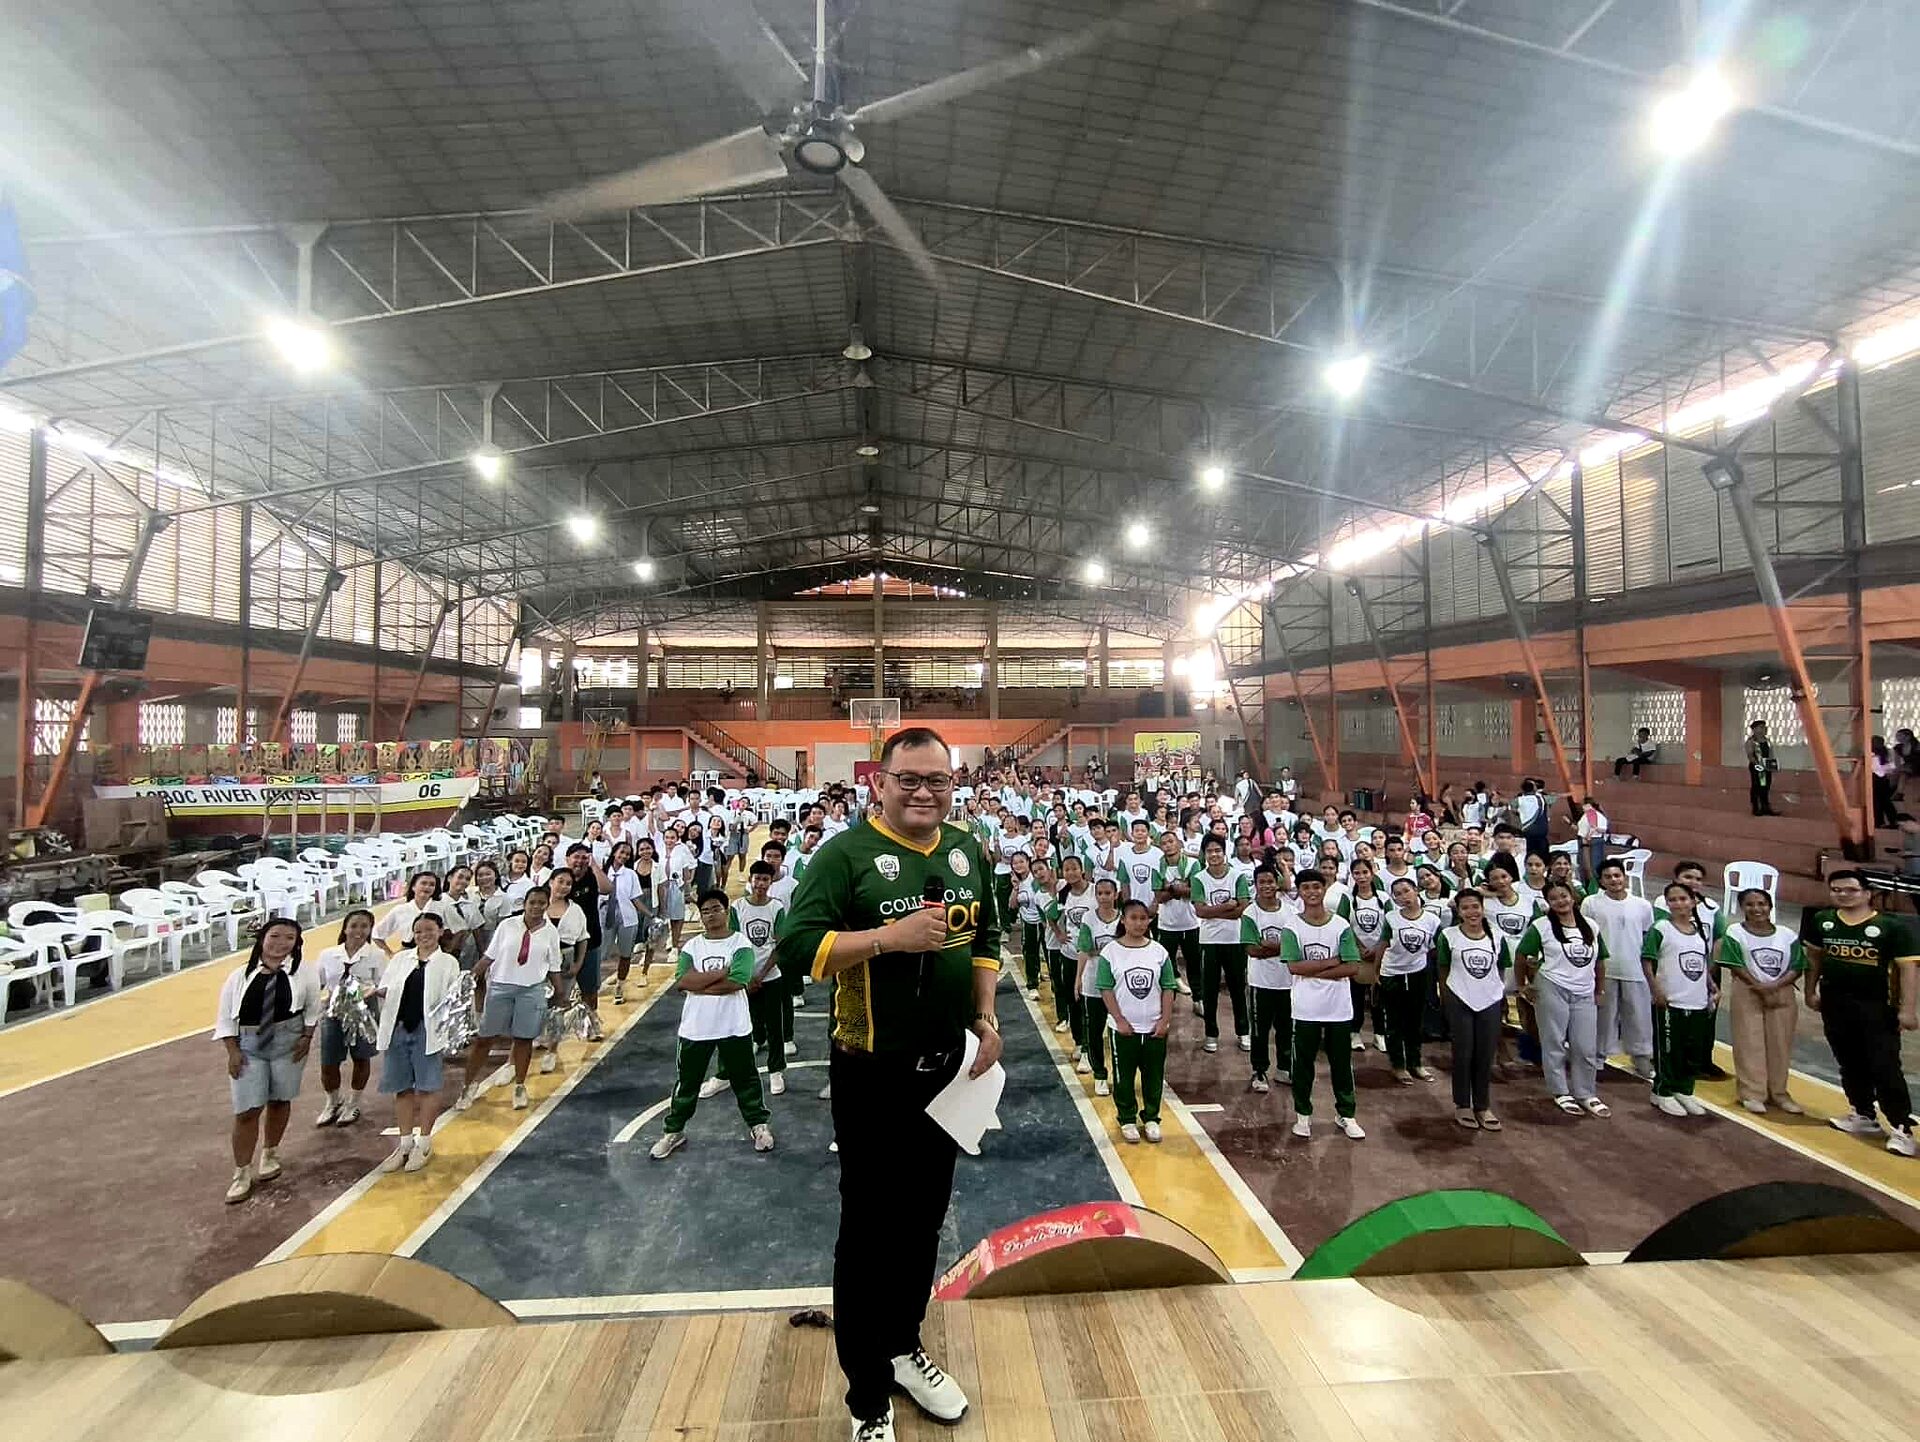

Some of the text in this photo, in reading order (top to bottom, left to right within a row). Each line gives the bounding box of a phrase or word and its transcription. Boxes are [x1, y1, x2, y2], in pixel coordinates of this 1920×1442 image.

[201, 788, 257, 803] RIVER
[260, 788, 322, 801] CRUSE
[418, 783, 441, 798] 06
[959, 887, 974, 901] de
